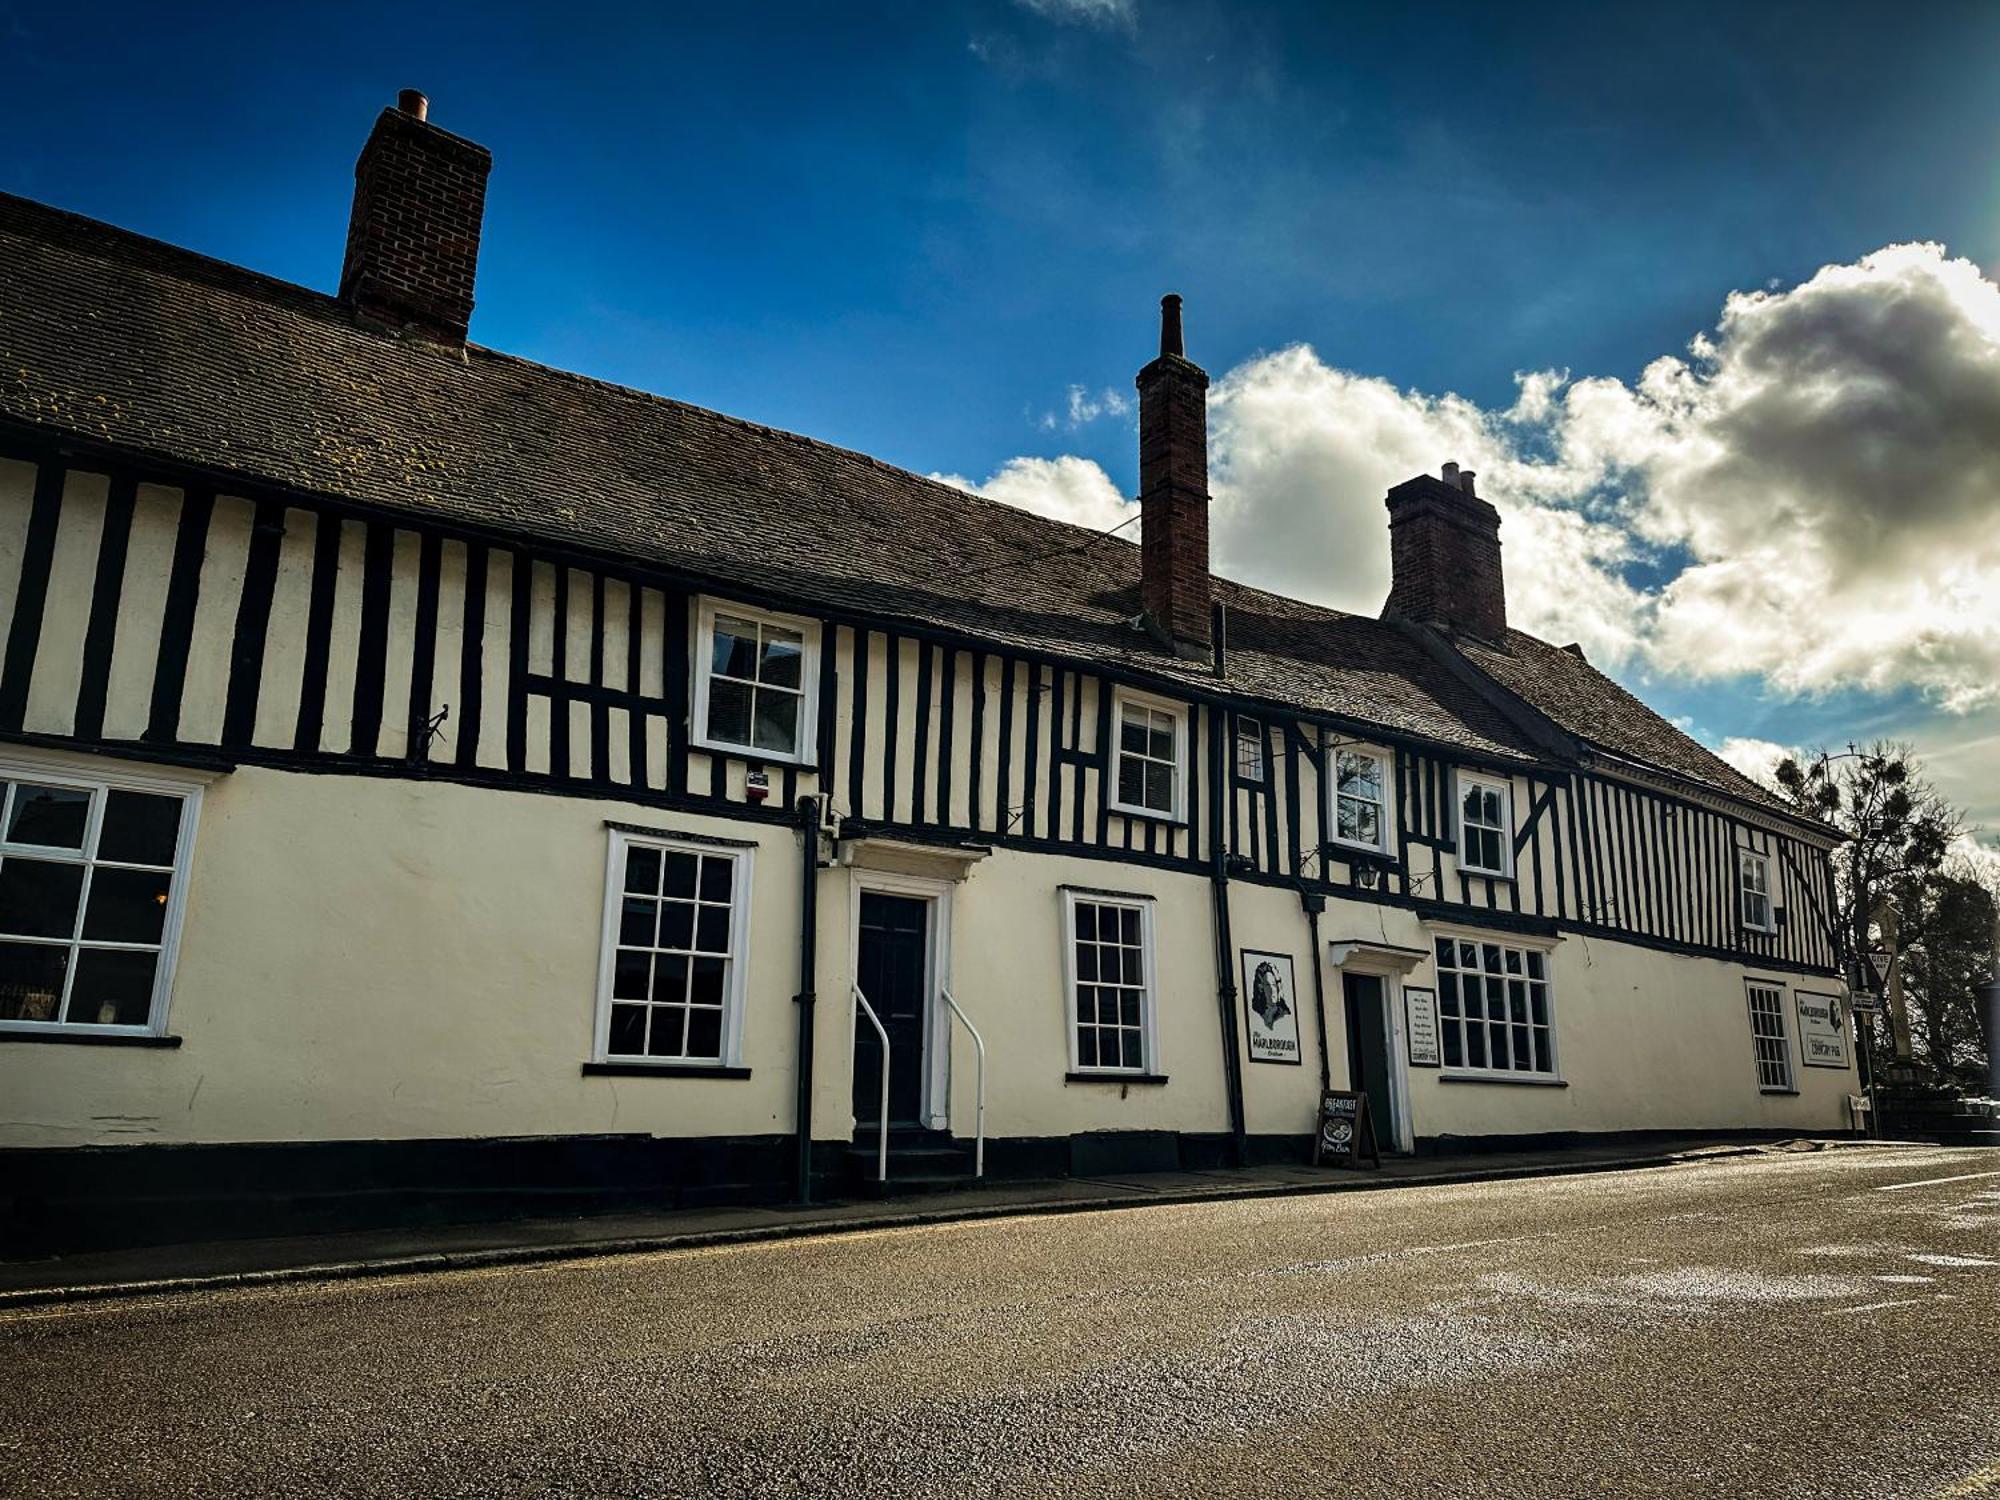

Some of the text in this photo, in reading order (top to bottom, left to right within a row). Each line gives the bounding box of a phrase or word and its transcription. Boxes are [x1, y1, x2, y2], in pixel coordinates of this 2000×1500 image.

[1871, 955, 1889, 963] GIVE
[1252, 1037, 1296, 1051] MARLBOROUGH
[1325, 1097, 1357, 1111] BREAKFAST
